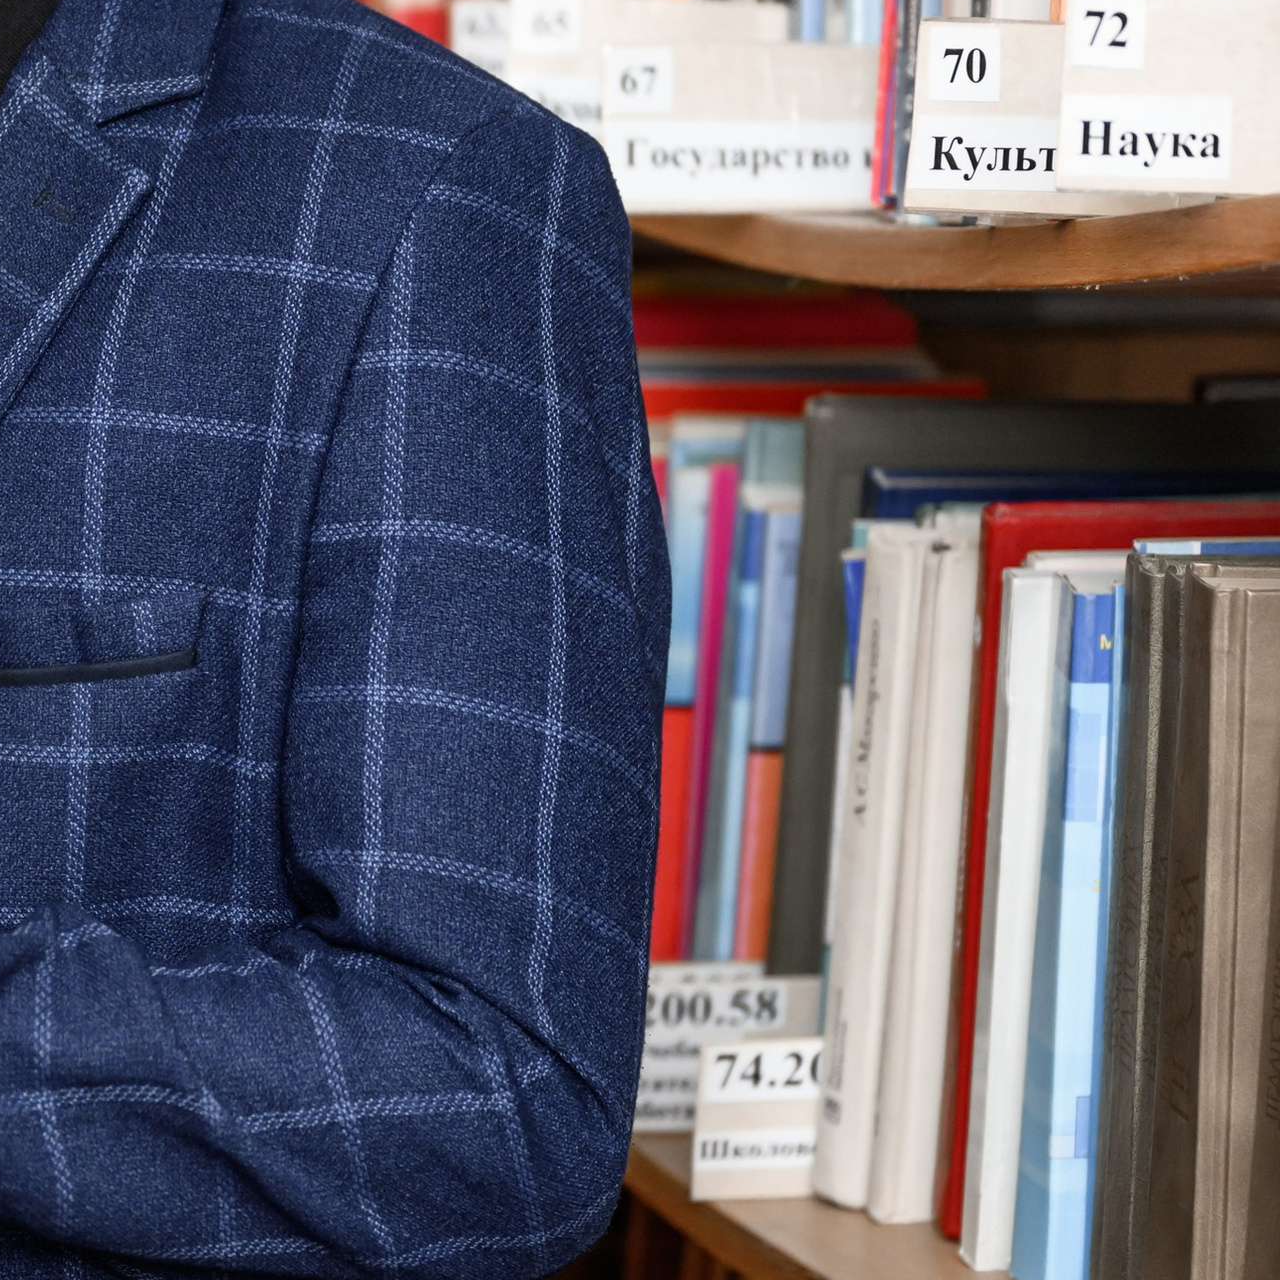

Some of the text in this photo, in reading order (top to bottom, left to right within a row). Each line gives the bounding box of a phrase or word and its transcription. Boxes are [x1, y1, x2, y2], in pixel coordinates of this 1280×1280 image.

[1085, 10, 1128, 48] 72
[621, 67, 657, 96] 67
[942, 47, 988, 84] 70
[625, 140, 851, 176] Государство
[930, 135, 1056, 181] Культ
[1080, 119, 1221, 168] Наука
